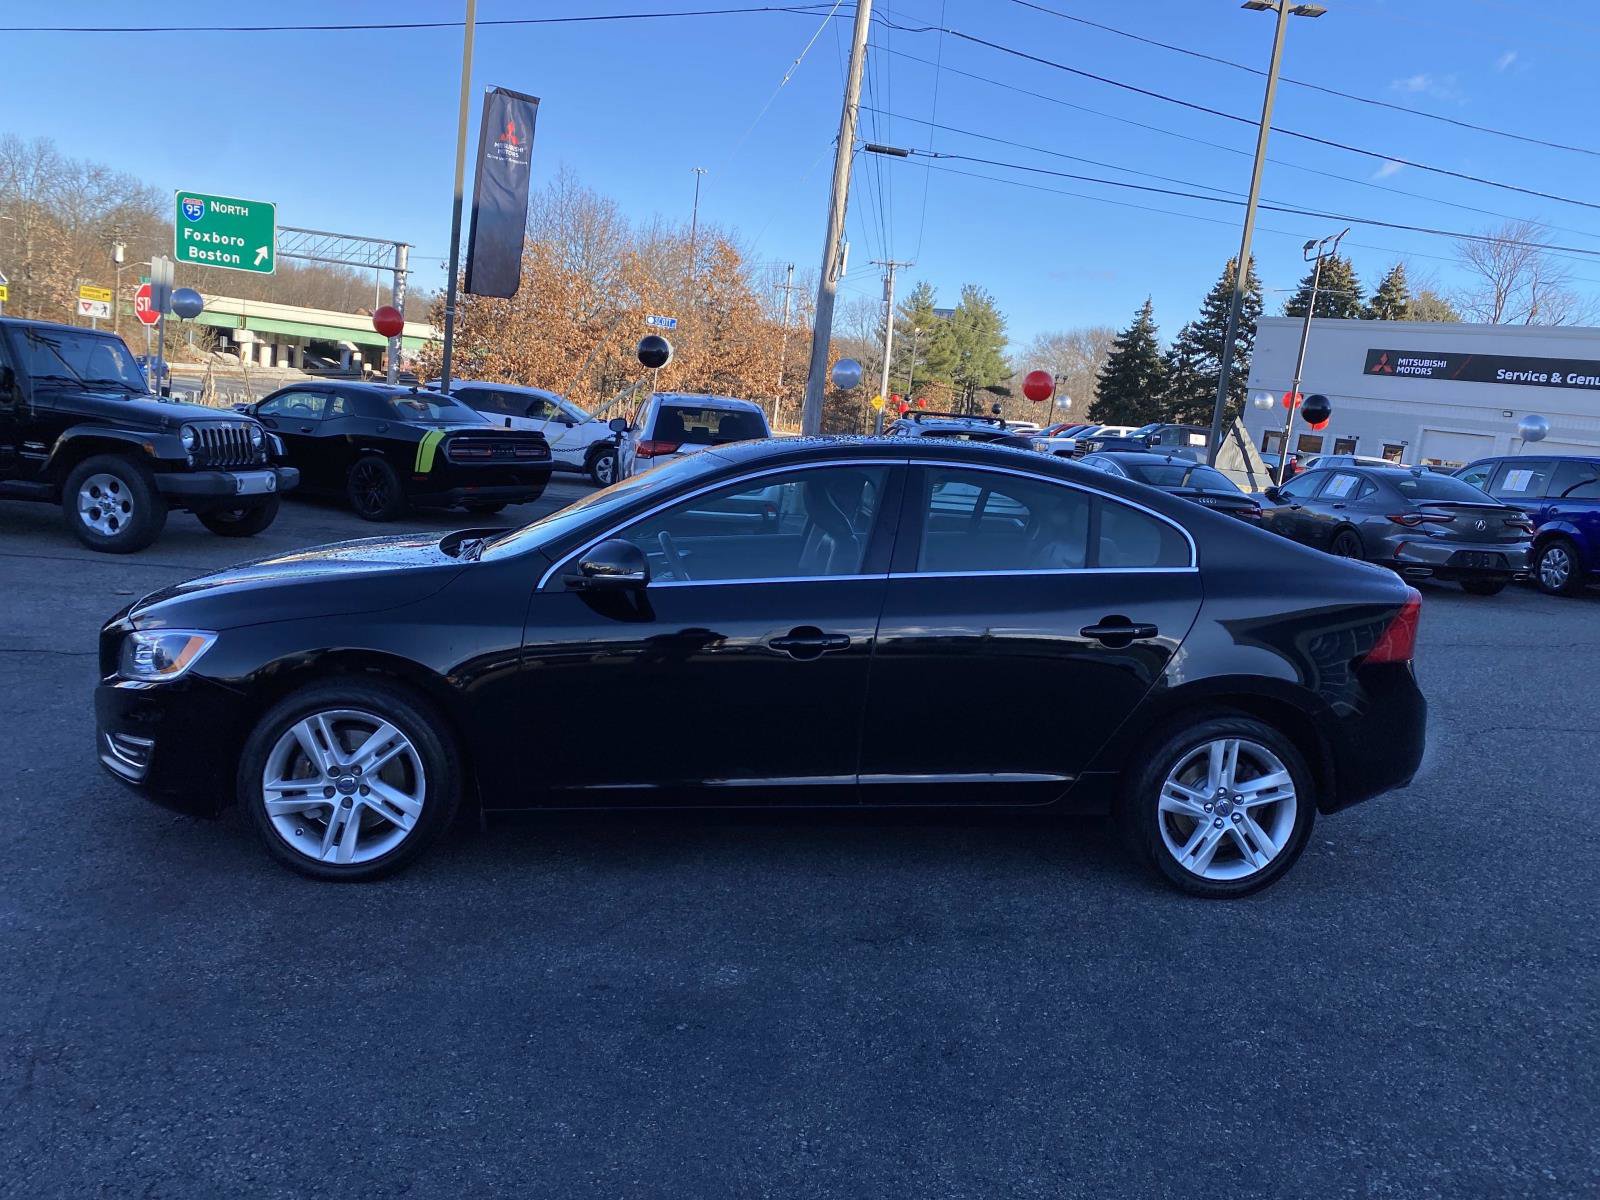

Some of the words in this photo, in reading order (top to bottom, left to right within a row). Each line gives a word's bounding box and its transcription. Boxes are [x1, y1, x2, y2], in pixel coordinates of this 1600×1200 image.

[186, 204, 201, 216] 95
[210, 201, 249, 217] NORTH
[184, 227, 245, 247] Foxboro
[189, 245, 240, 264] Boston
[137, 296, 151, 312] ST
[1396, 366, 1433, 375] MOTORS
[1398, 358, 1447, 368] MITSUBISHI
[1496, 368, 1548, 382] Service
[1550, 372, 1562, 383] &
